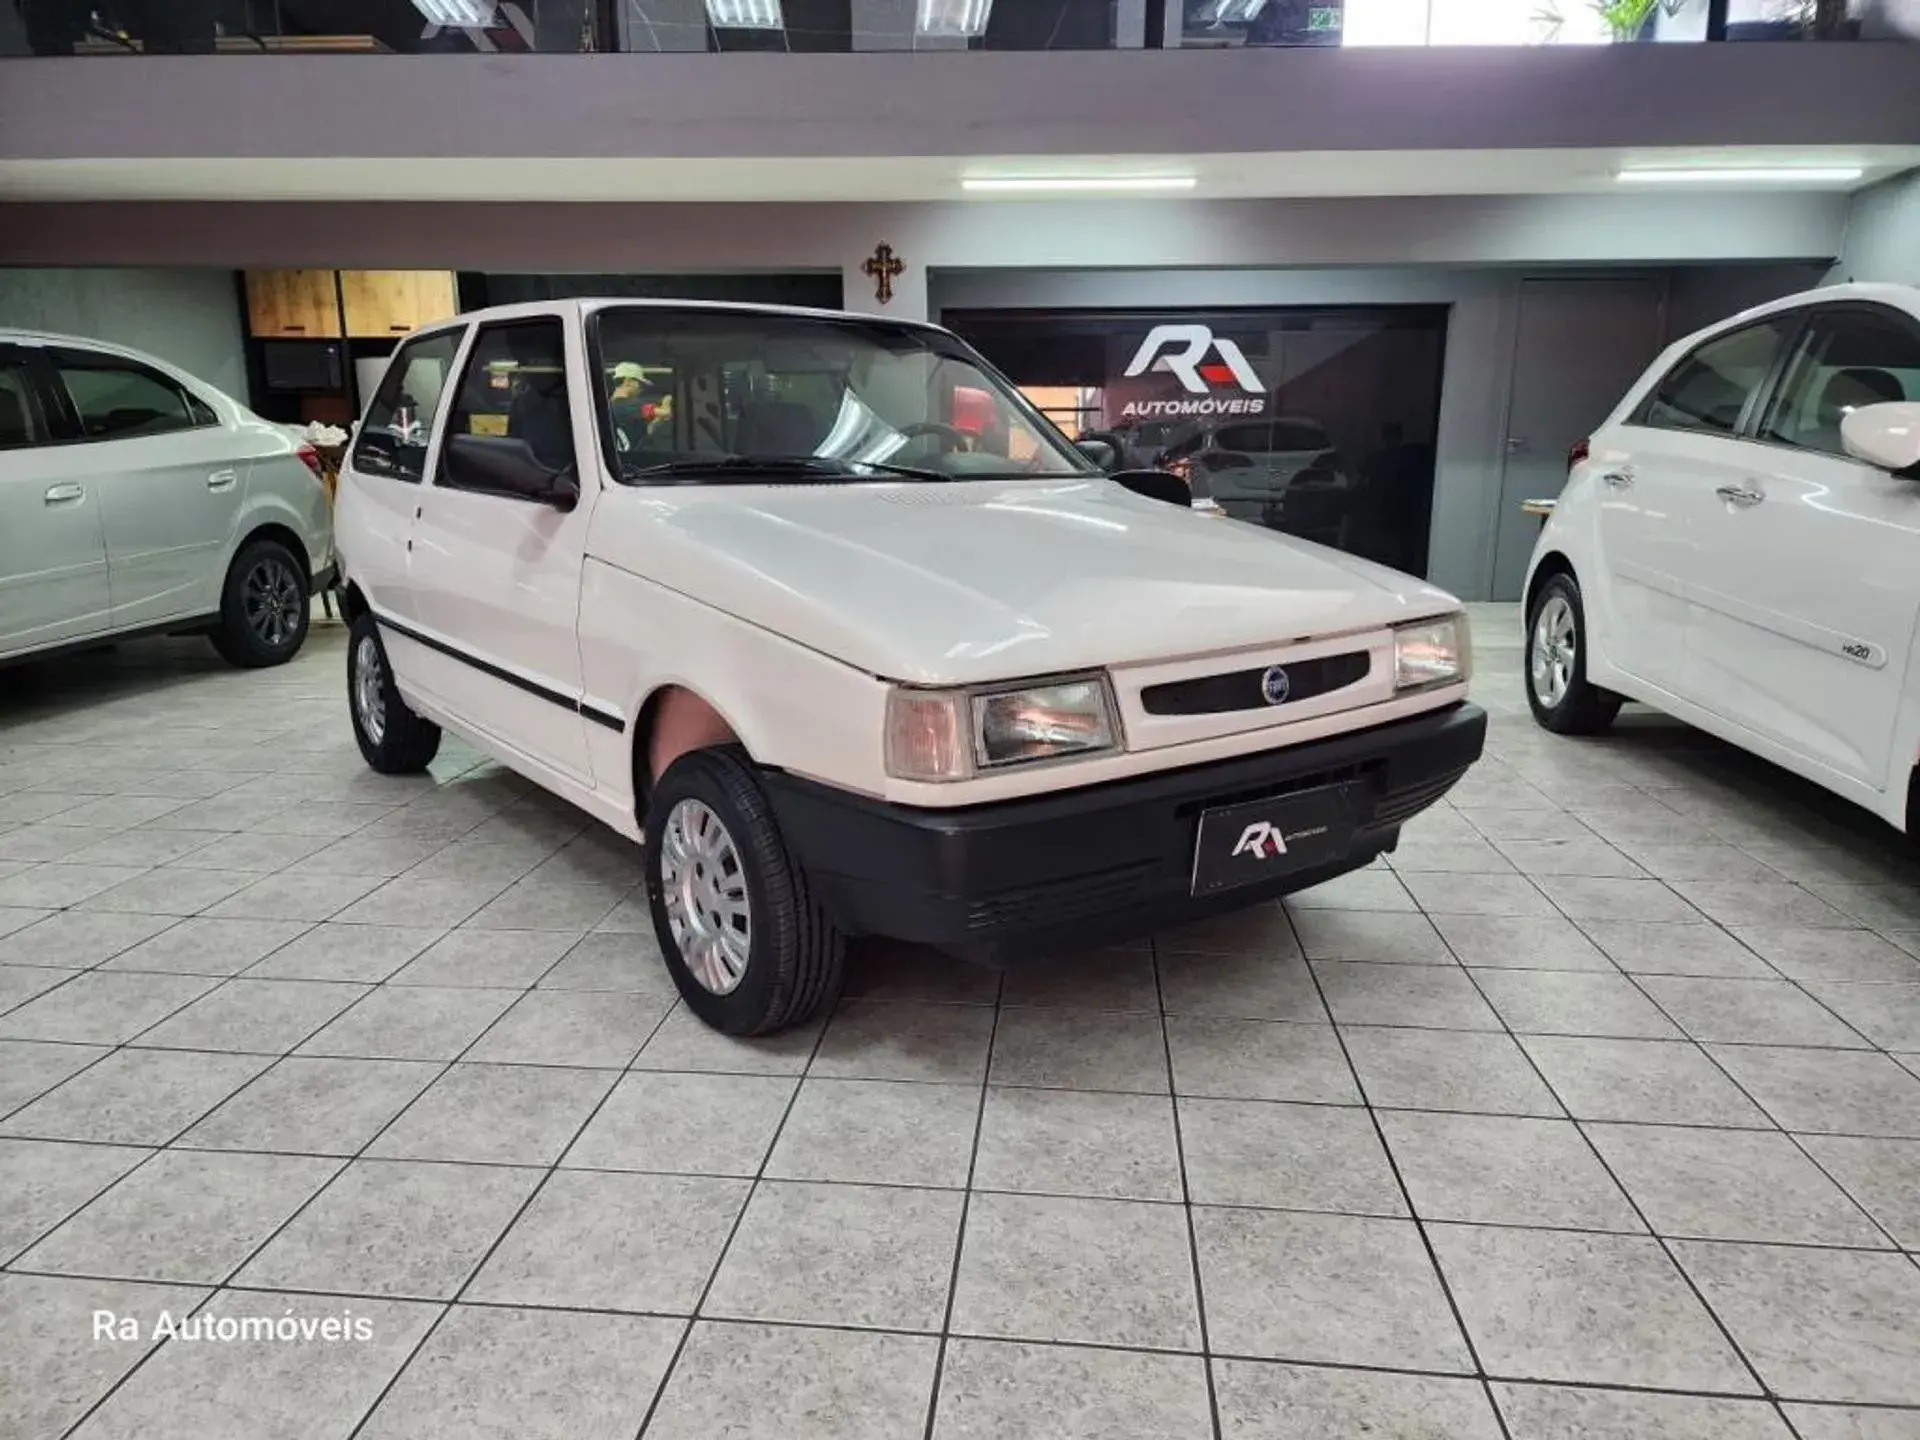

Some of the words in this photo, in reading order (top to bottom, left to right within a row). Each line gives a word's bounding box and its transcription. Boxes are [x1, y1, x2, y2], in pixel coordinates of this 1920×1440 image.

[1124, 324, 1267, 393] RA
[1121, 398, 1266, 416] AUTOMÓVEIS
[1231, 820, 1288, 859] RA
